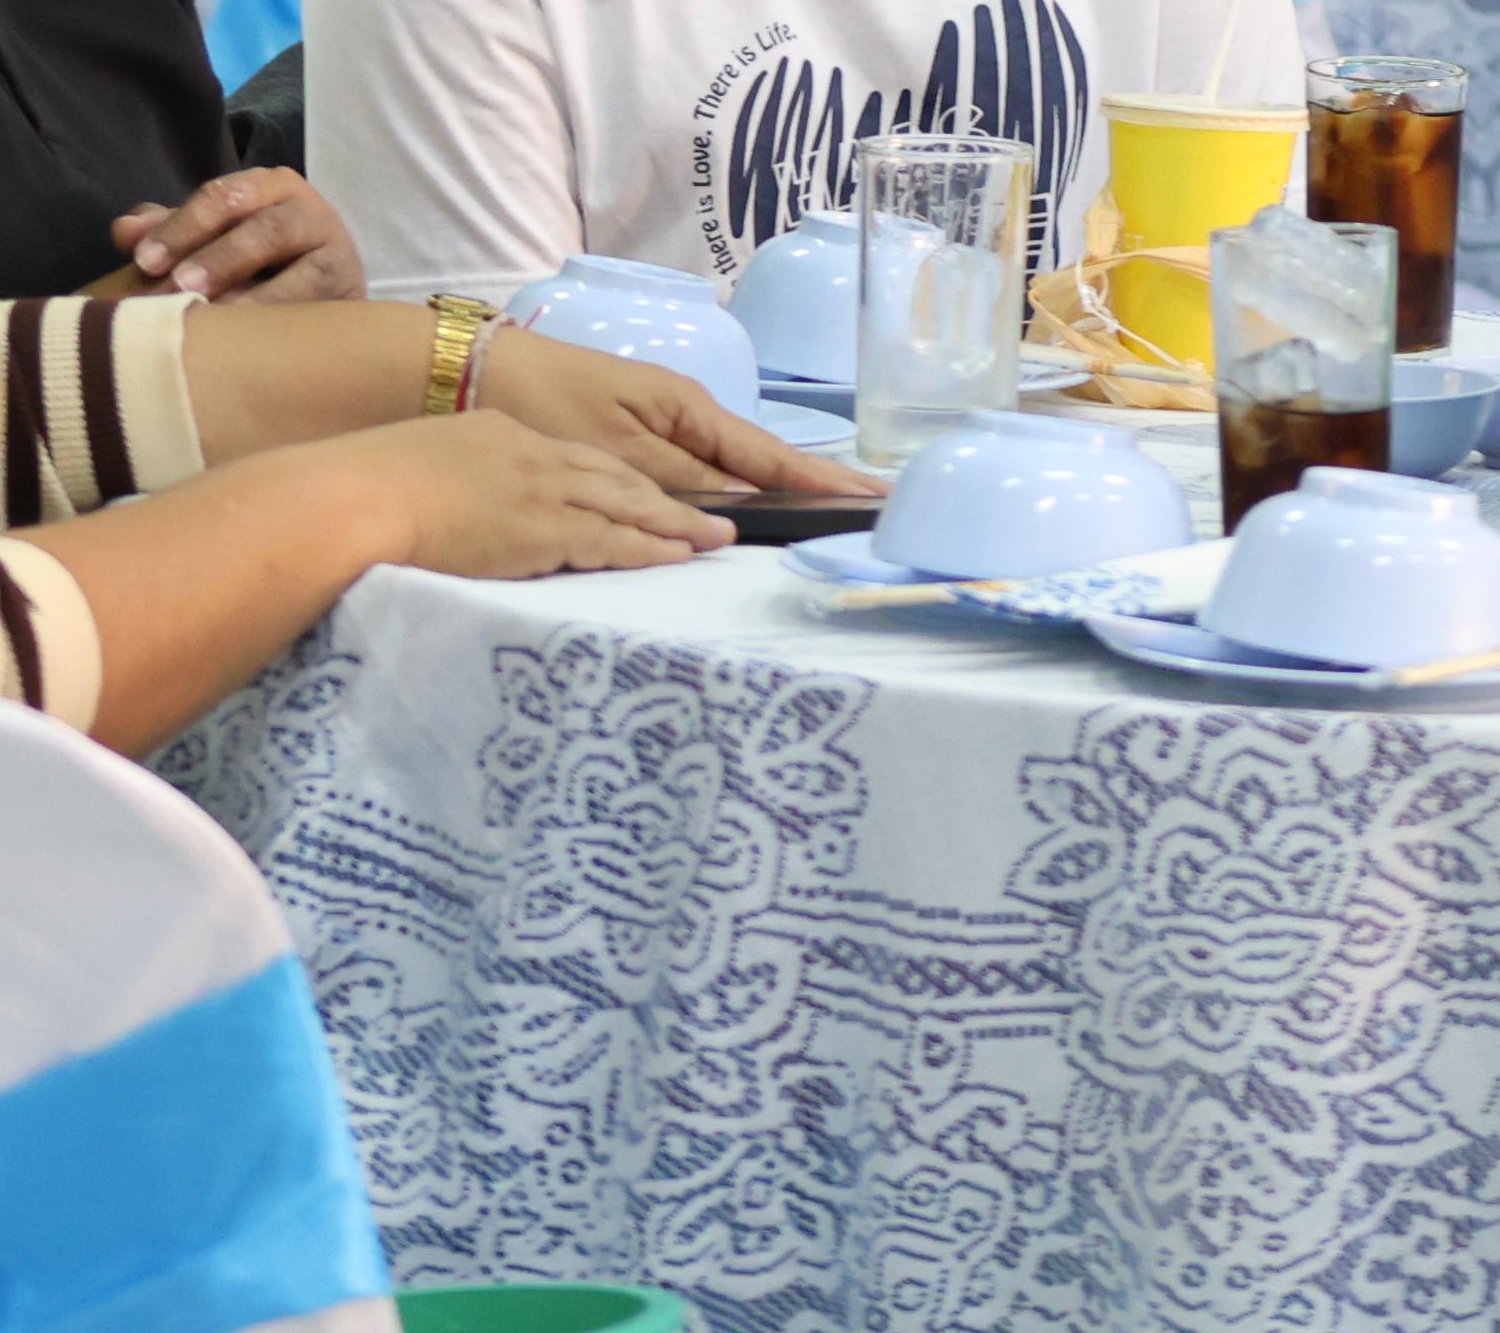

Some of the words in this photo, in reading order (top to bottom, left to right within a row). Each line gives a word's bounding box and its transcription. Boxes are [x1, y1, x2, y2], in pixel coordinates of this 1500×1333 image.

[731, 45, 757, 68] is
[693, 63, 740, 121] There
[695, 193, 715, 215] is
